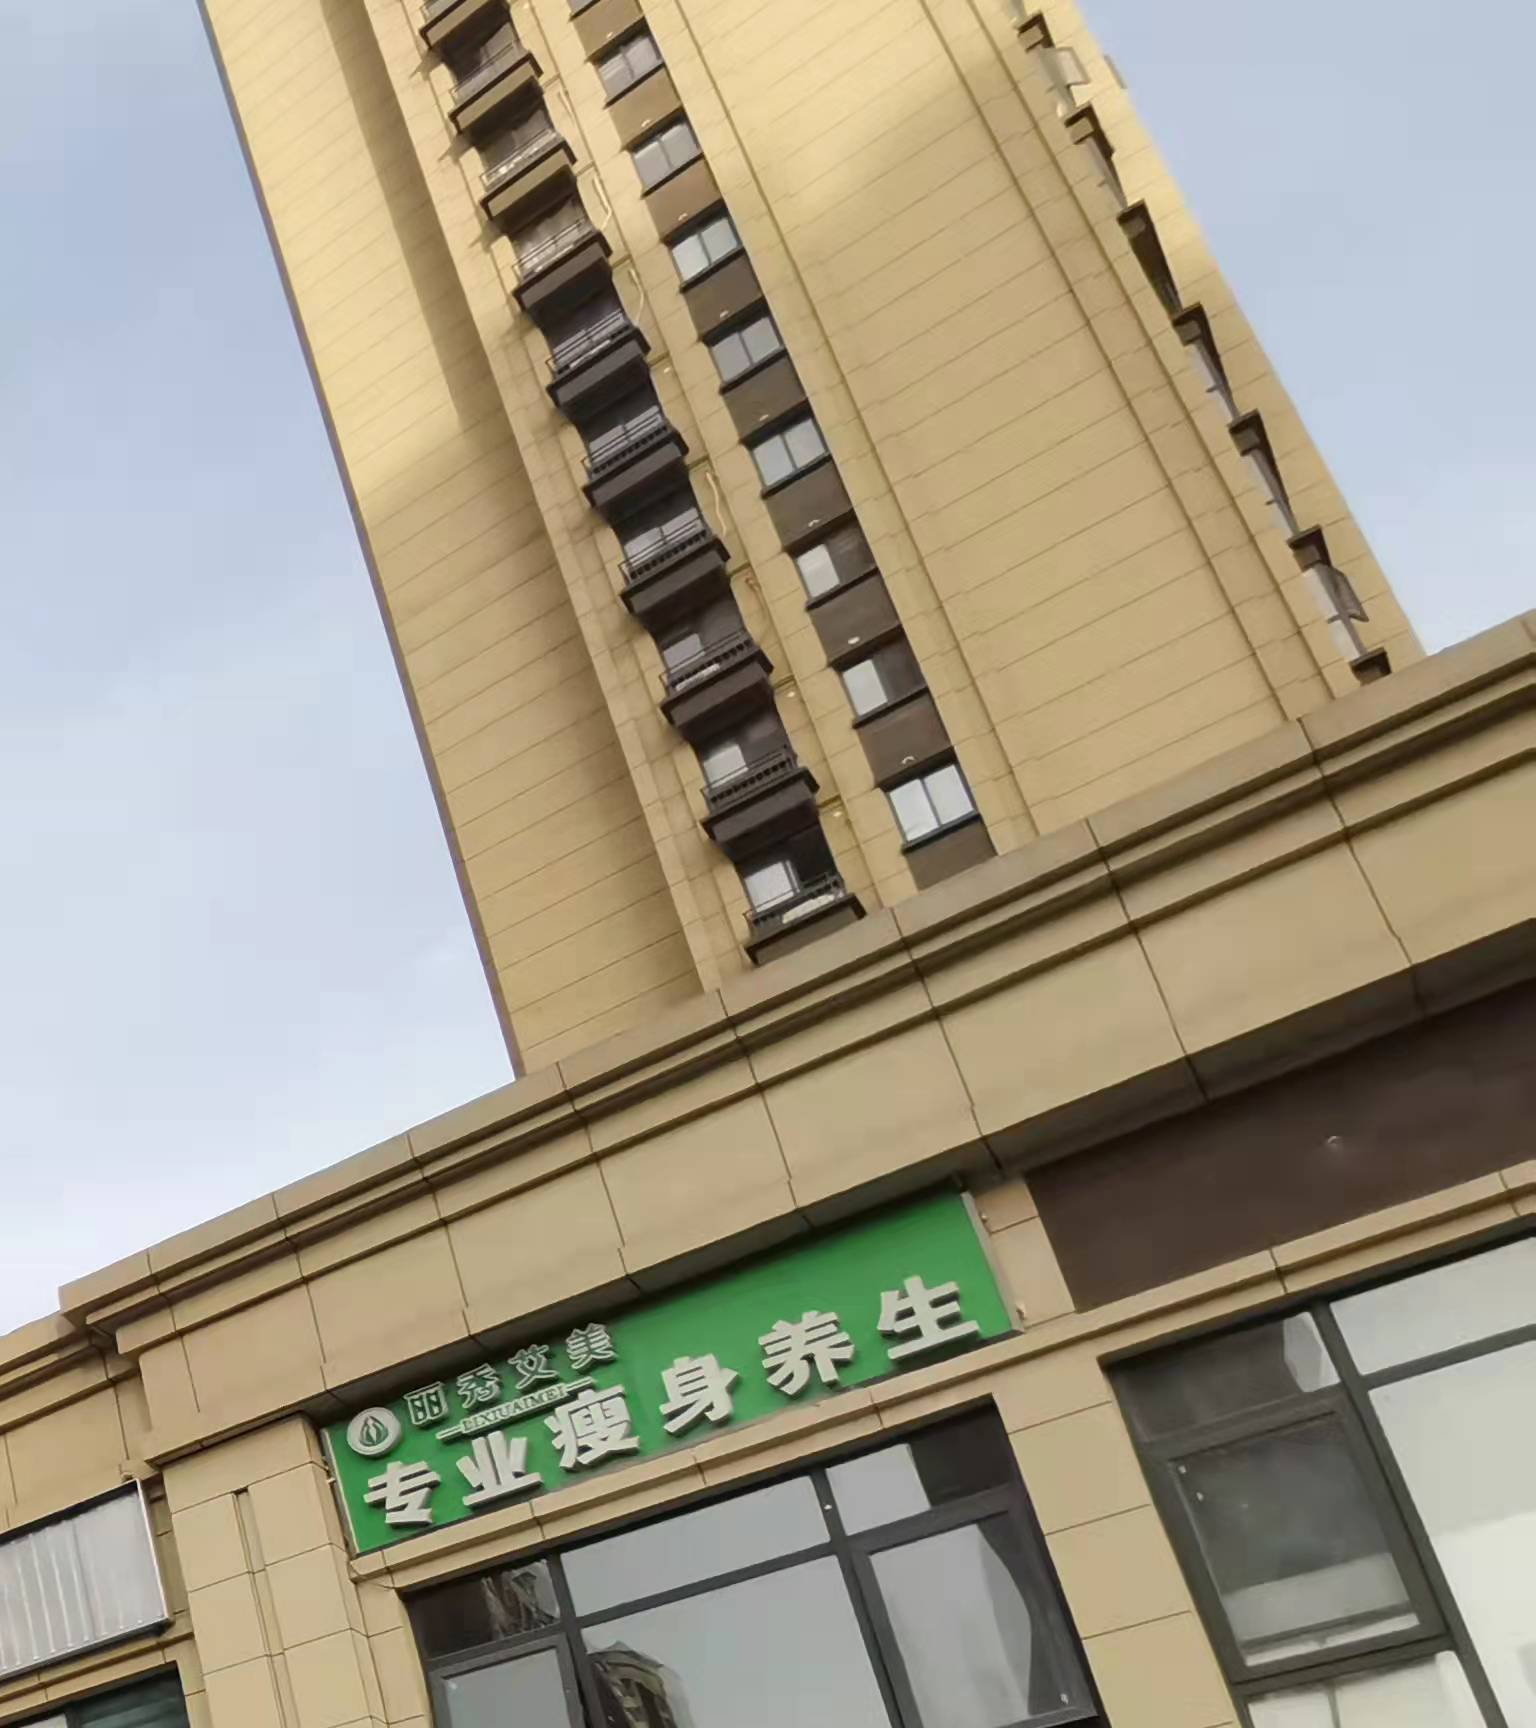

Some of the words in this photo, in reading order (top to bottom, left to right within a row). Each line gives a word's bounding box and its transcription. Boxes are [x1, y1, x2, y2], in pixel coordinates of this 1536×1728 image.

[364, 1276, 980, 1528] 专业瘦身养生
